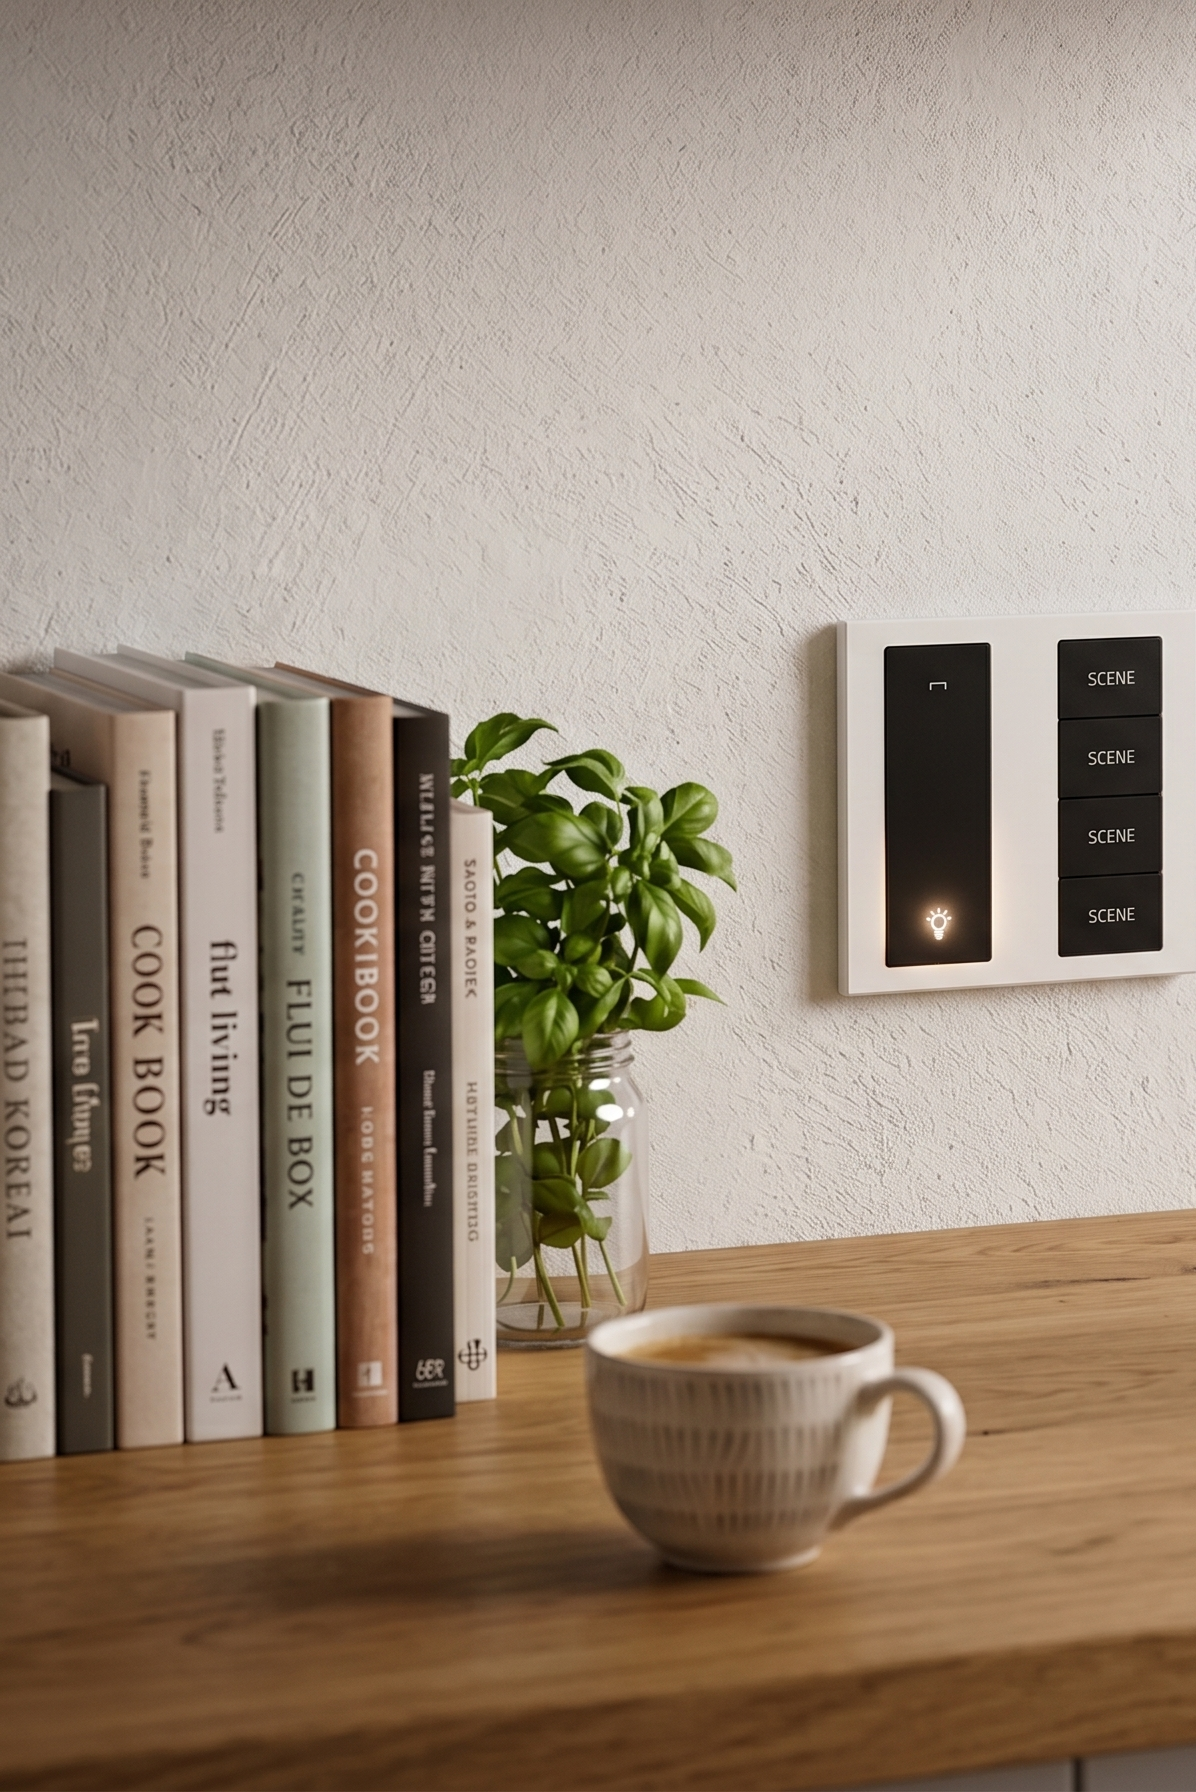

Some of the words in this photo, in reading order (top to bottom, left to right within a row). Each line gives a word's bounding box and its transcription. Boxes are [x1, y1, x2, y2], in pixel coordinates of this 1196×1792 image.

[1087, 670, 1136, 687] SCENE
[1087, 749, 1136, 766] SCENE
[1088, 828, 1136, 845] SCENE
[1088, 907, 1136, 924] SCENE
[133, 925, 163, 1036] COOK
[211, 941, 237, 997] flut
[287, 980, 312, 1058] FLUI
[204, 1012, 237, 1115] living
[133, 1057, 165, 1178] BOOK
[288, 1075, 312, 1120] DE
[5, 1099, 32, 1238] KOREAI
[288, 1137, 313, 1209] BOX
